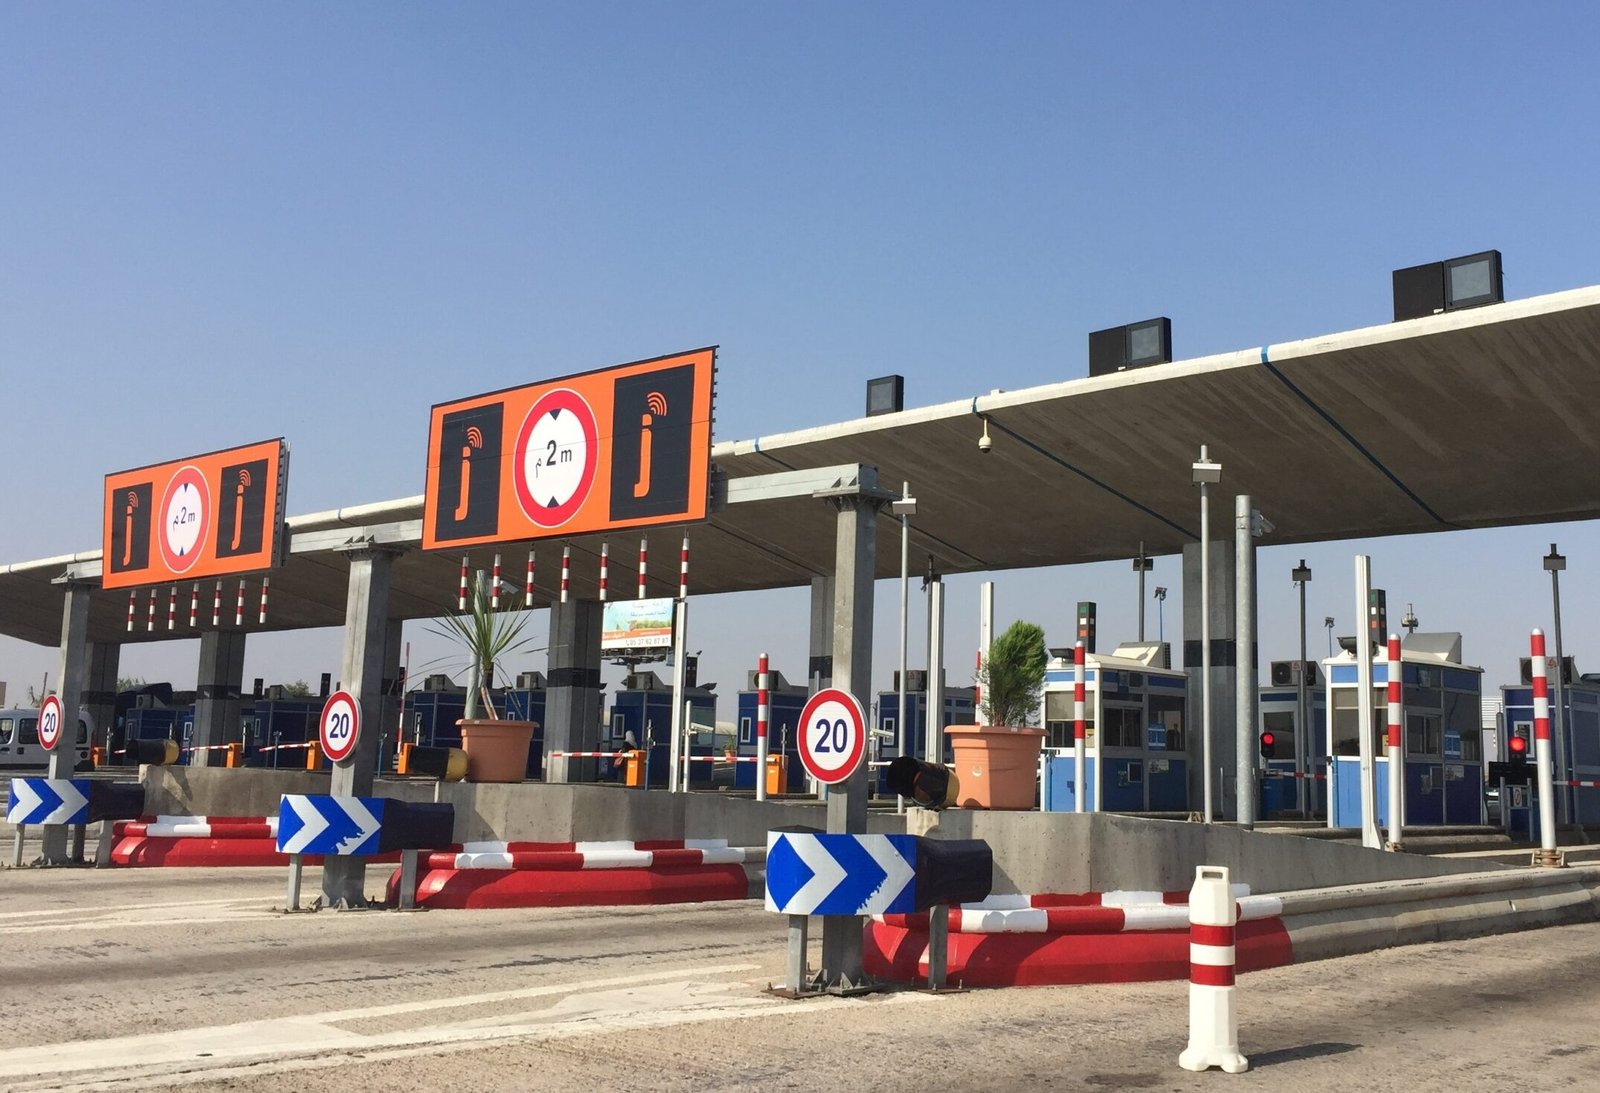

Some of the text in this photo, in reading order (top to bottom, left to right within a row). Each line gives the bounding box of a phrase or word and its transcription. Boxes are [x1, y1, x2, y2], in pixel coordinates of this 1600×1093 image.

[546, 439, 557, 467] 2
[560, 448, 572, 463] m
[180, 506, 187, 524] 2
[188, 511, 196, 523] m
[44, 712, 56, 733] 20
[329, 712, 350, 739] 20
[814, 718, 848, 753] 20
